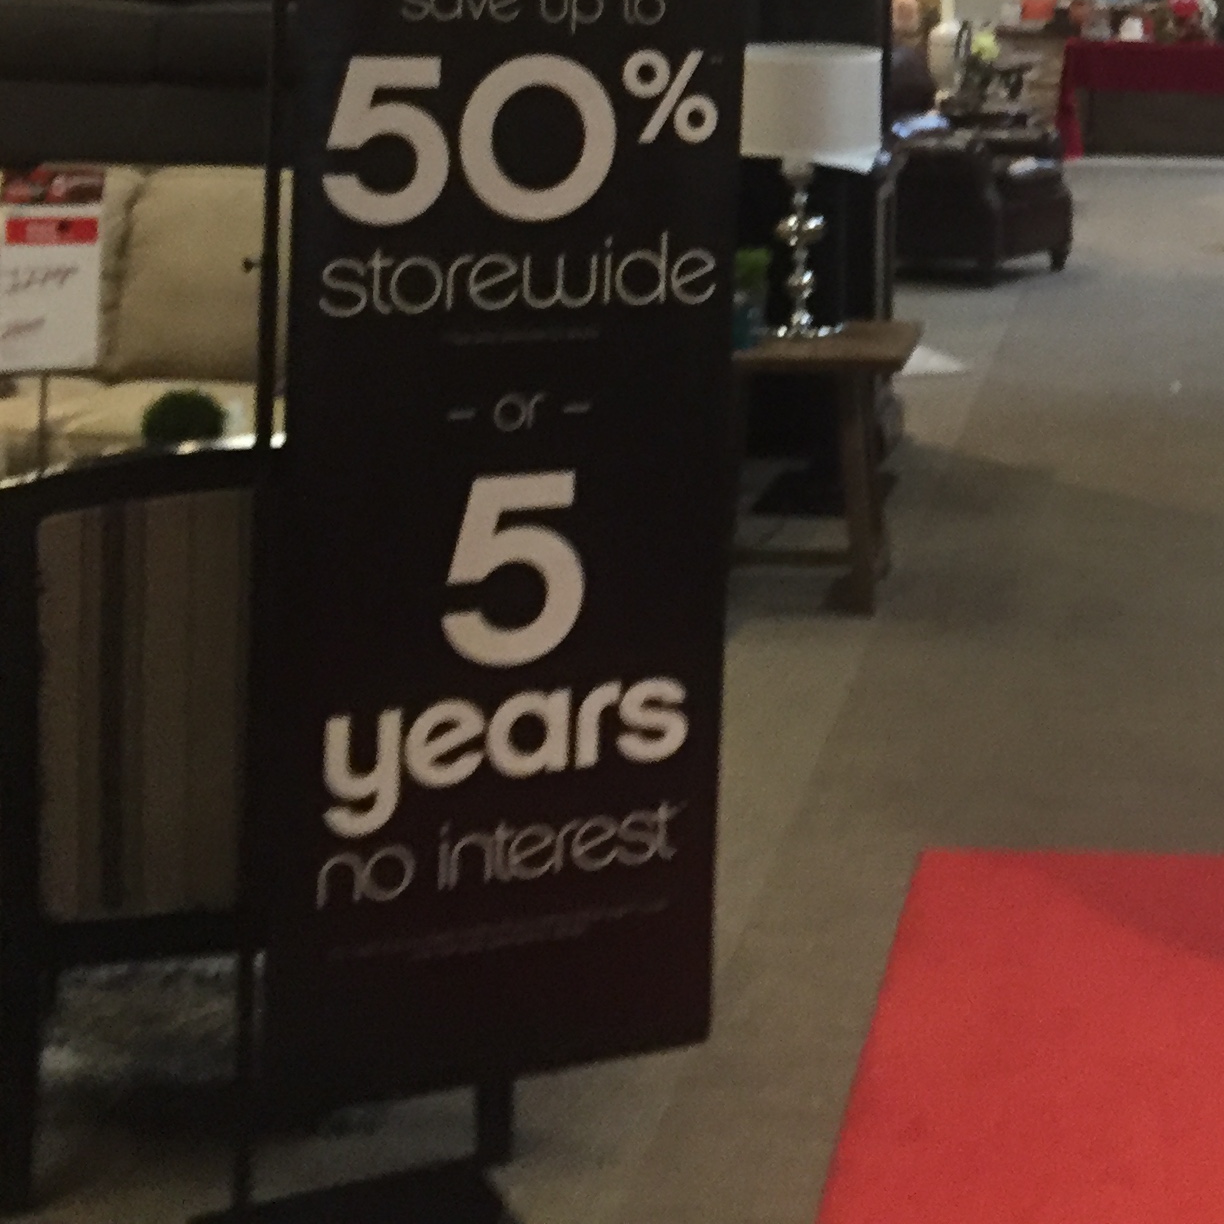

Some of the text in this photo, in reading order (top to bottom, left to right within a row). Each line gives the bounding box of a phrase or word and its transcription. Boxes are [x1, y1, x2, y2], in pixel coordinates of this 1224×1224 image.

[321, 48, 720, 228] 50%
[318, 230, 717, 318] storewide
[493, 392, 546, 432] or
[440, 469, 586, 668] 5
[322, 676, 689, 839] years
[315, 800, 685, 910] no interest
